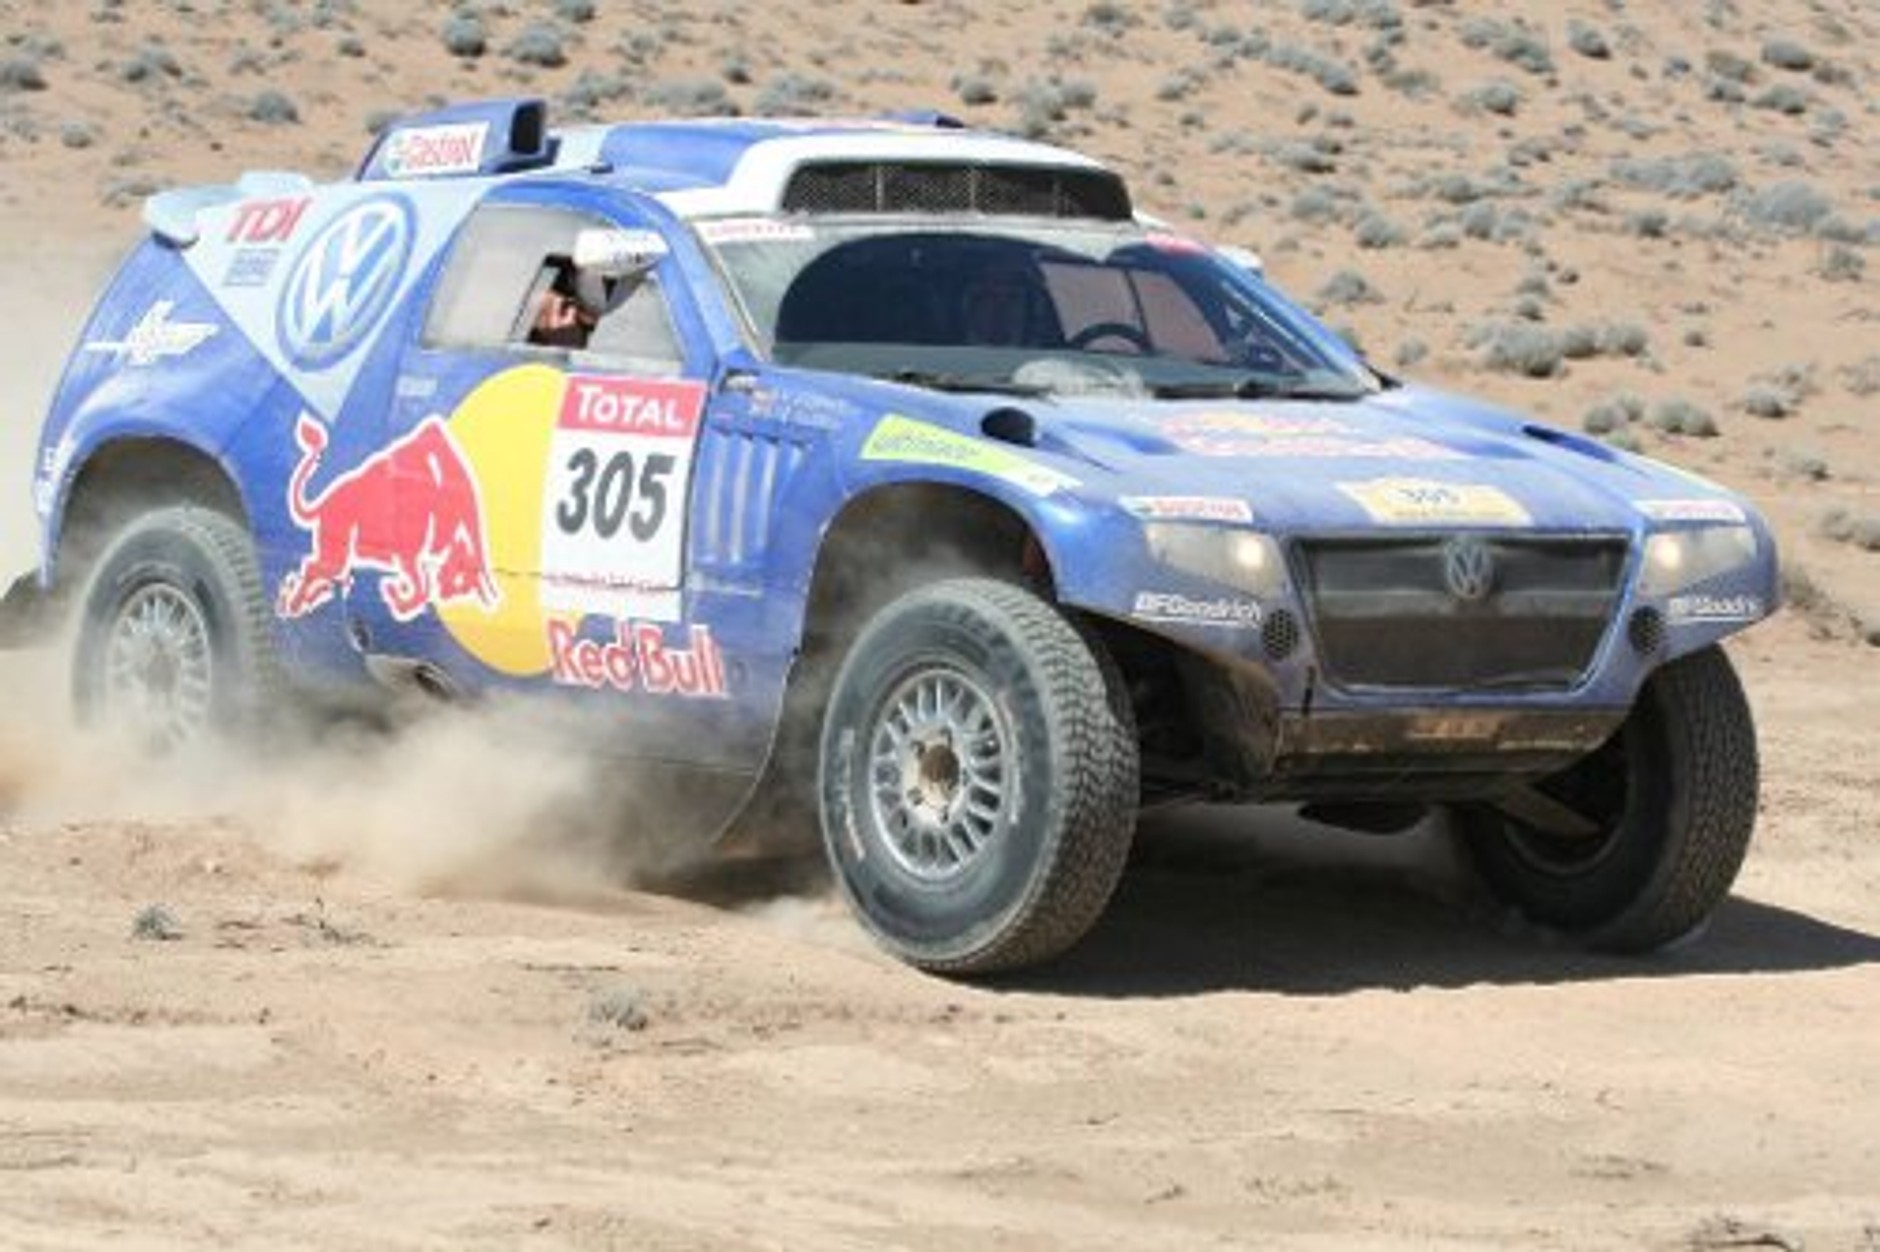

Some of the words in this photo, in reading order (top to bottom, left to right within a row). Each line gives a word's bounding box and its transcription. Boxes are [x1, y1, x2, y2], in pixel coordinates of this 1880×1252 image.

[226, 196, 313, 242] TDI
[557, 447, 678, 542] 305
[547, 617, 634, 691] Red
[636, 623, 727, 697] Bull
